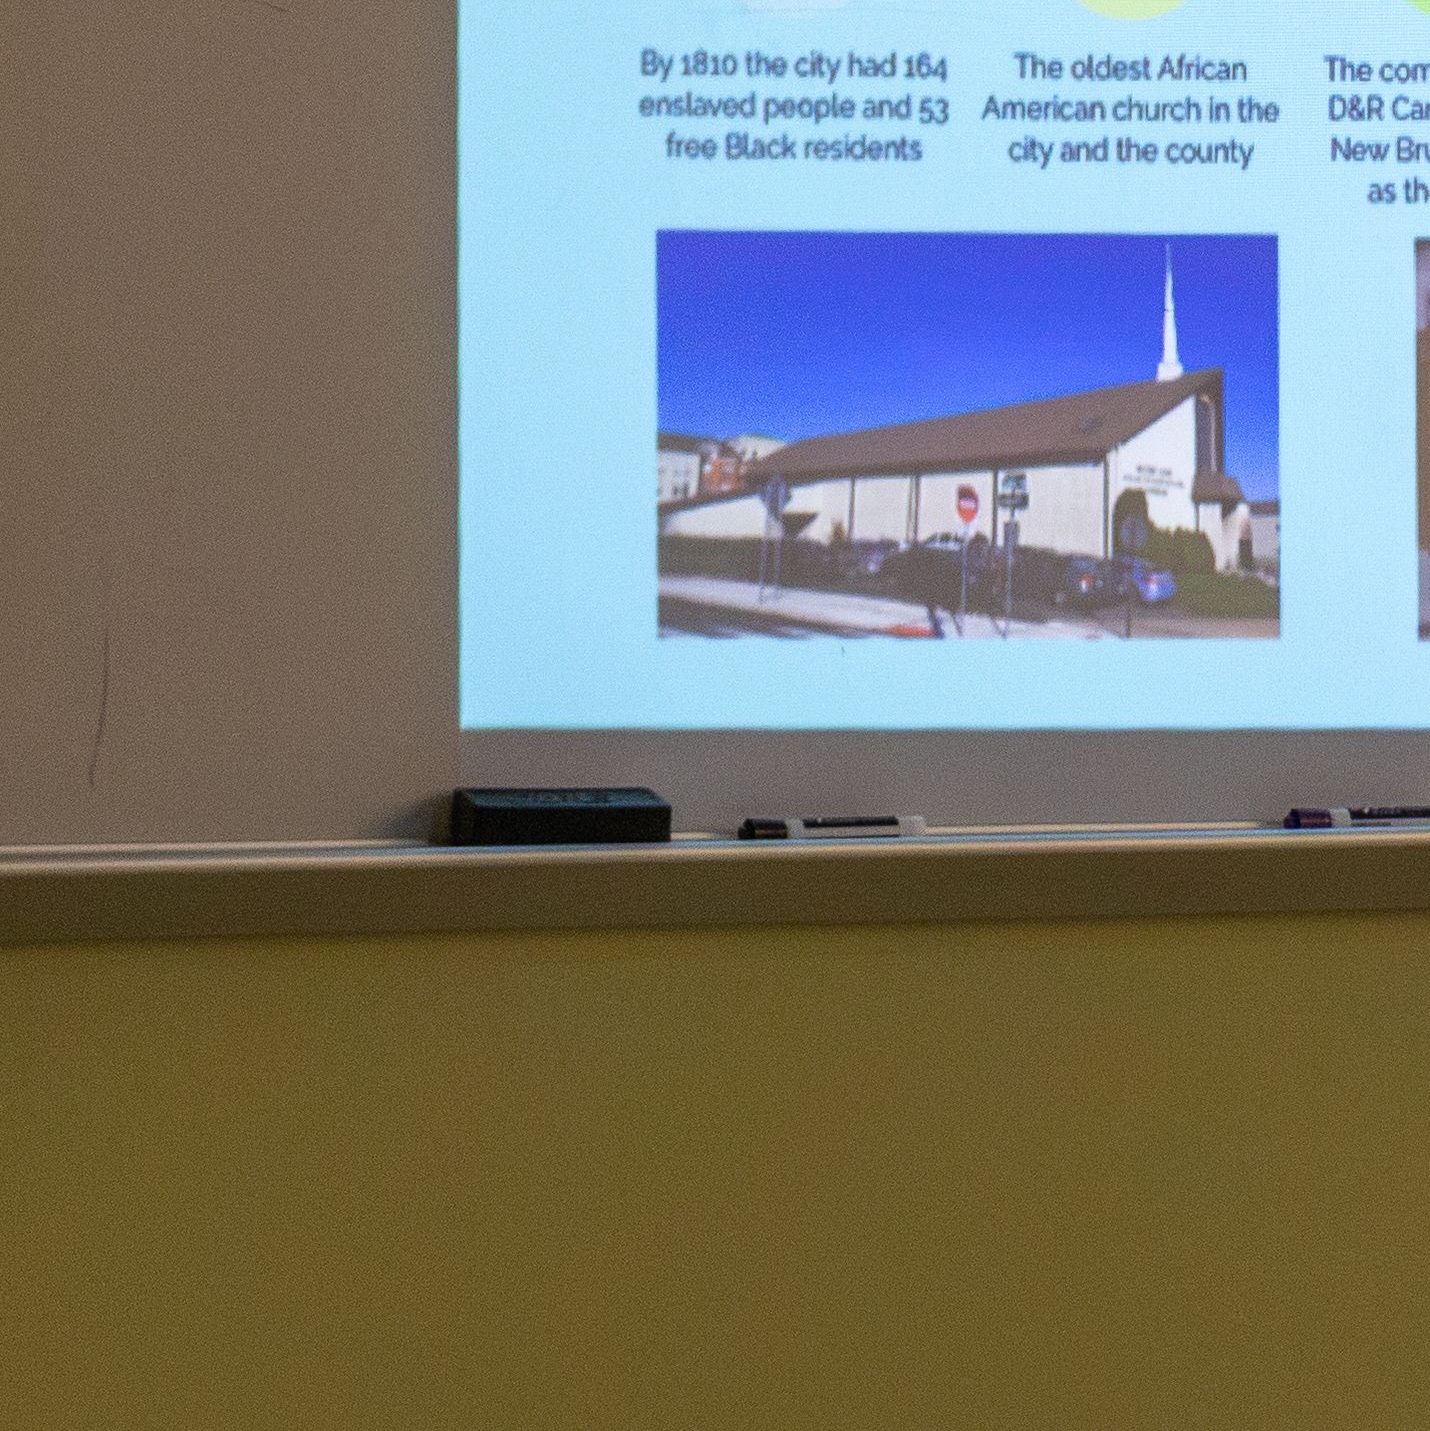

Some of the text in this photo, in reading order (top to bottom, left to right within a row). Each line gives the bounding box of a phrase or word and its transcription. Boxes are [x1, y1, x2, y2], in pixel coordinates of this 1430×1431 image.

[640, 47, 948, 85] By 1810 the city had 164
[1013, 51, 1248, 82] The oldest African
[1323, 54, 1374, 83] The
[637, 90, 950, 126] enslaved people and 53
[980, 94, 1281, 124] American church in the
[1327, 93, 1385, 122] D&R
[664, 130, 924, 162] free Black residents
[1007, 135, 1255, 171] city and the county
[1330, 136, 1391, 162] New
[1366, 182, 1398, 205] as
